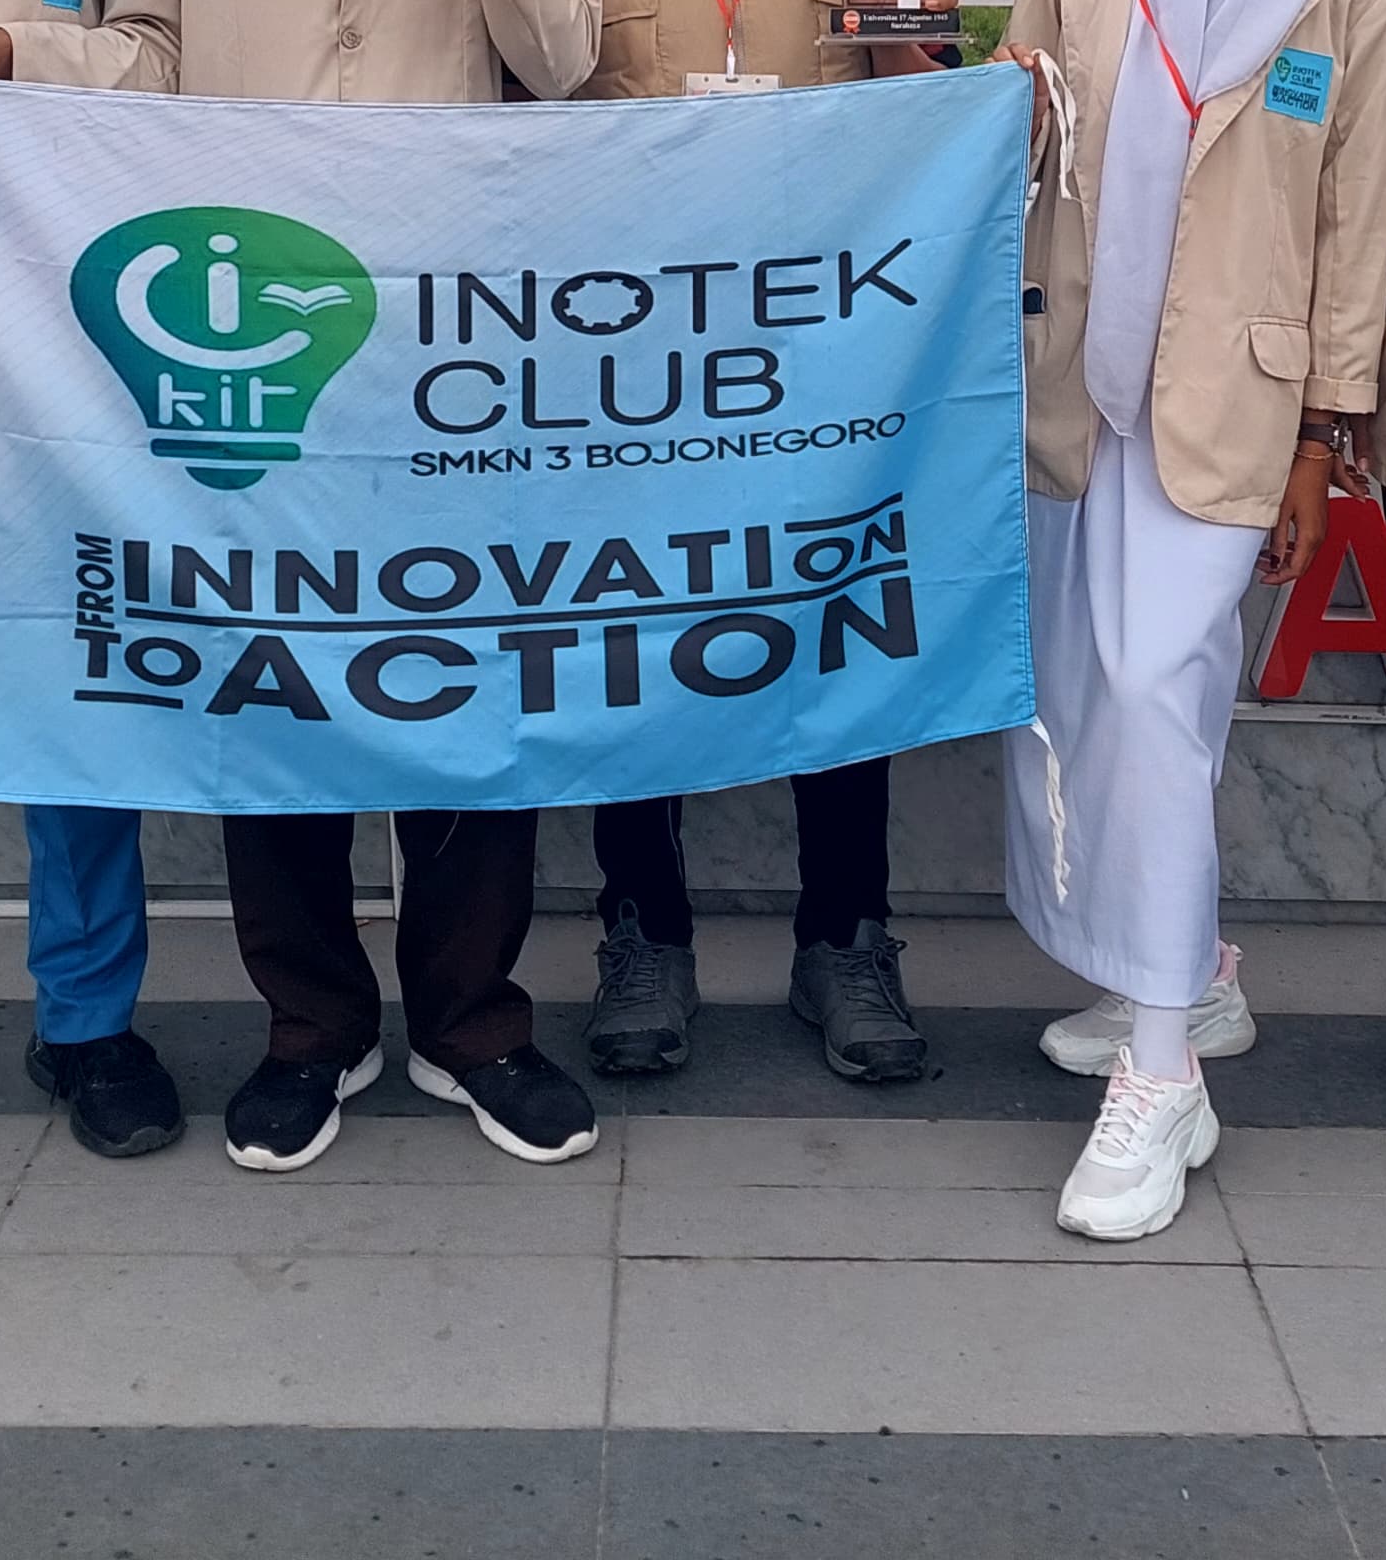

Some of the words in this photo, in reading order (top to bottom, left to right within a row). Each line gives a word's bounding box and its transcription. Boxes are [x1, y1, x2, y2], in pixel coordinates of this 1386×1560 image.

[418, 239, 918, 346] INOTEK
[413, 348, 785, 435] CLUB
[410, 447, 531, 477] SMKN
[545, 445, 571, 471] 3
[586, 412, 906, 468] BOJONEGORO
[75, 531, 115, 630] FROM
[123, 510, 907, 614] INNOVATION
[74, 627, 202, 688] TO
[204, 576, 919, 723] ACTION
